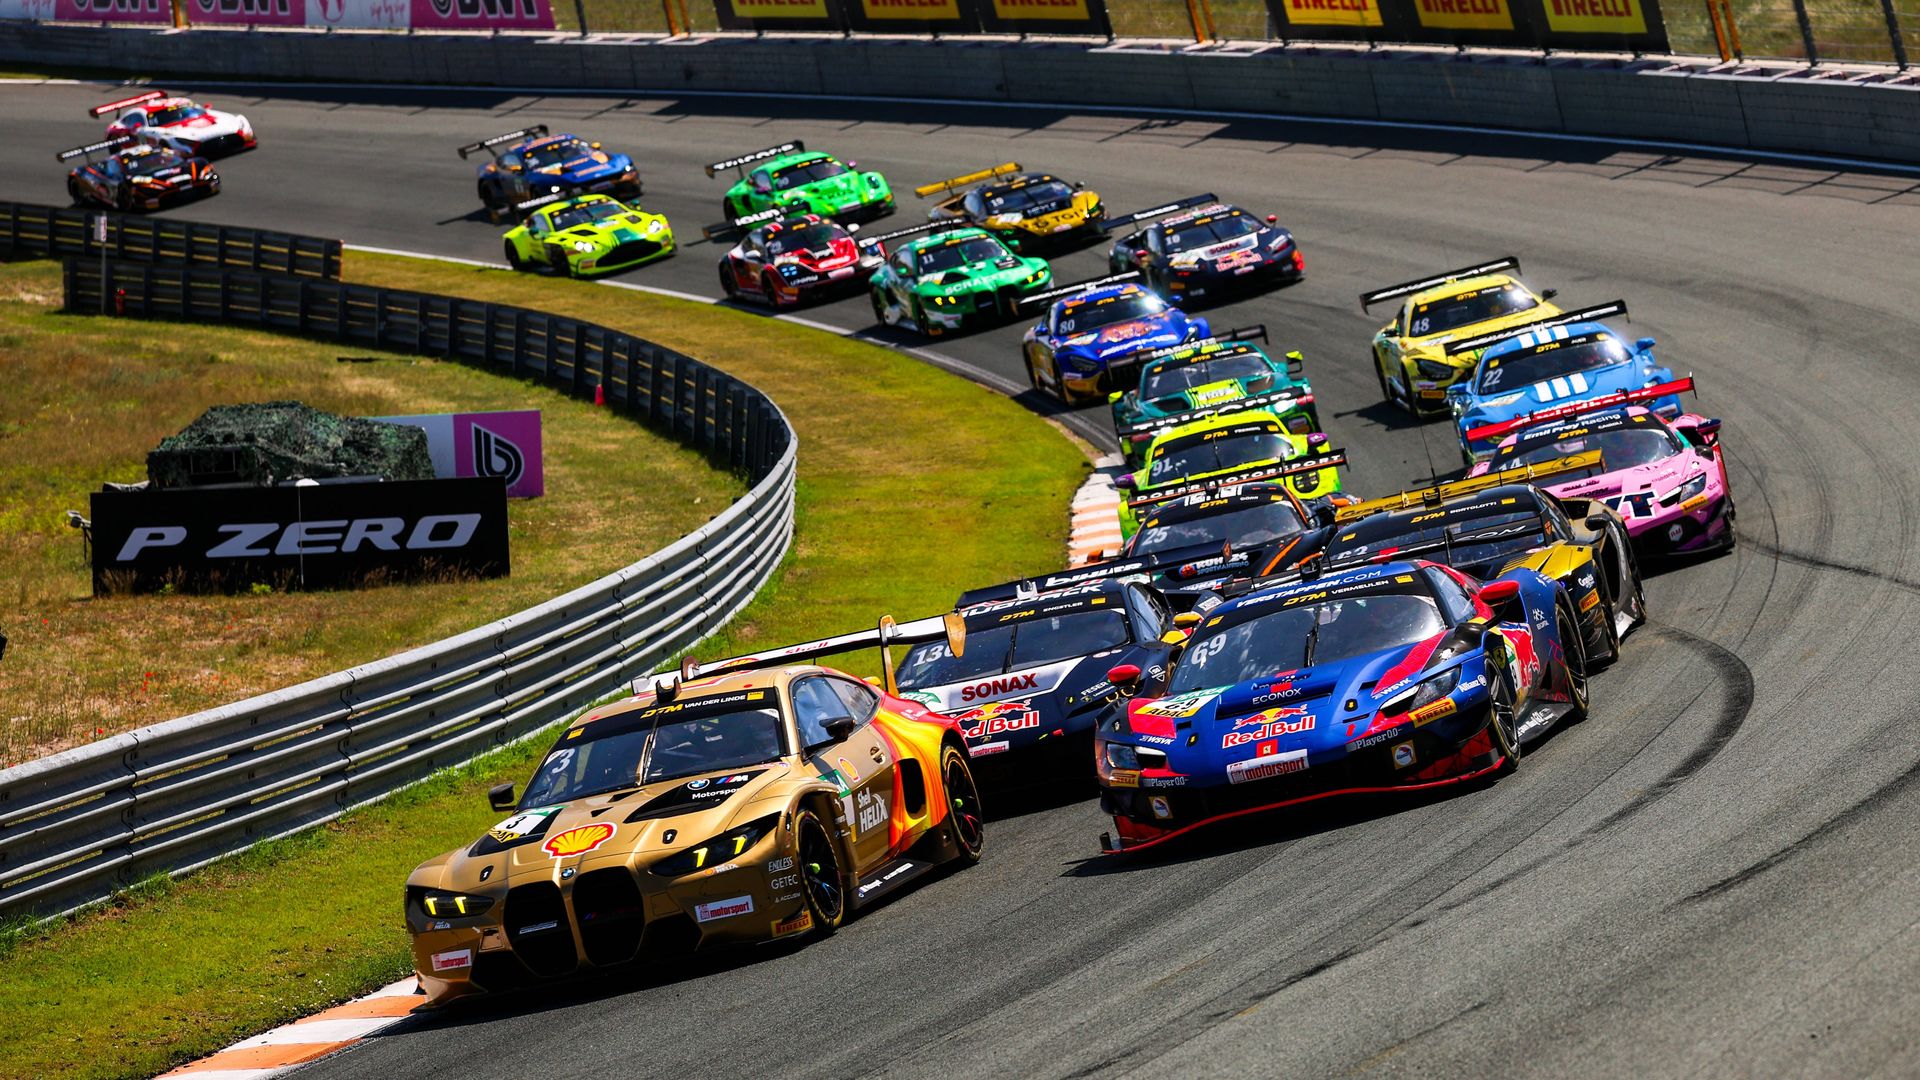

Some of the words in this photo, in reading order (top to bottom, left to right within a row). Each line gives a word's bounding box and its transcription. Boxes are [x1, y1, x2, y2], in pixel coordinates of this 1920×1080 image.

[1058, 319, 1075, 336] 80
[1412, 318, 1431, 334] 48
[1536, 343, 1560, 353] DTM
[1151, 376, 1161, 389] 7
[1483, 368, 1504, 388] 22
[1203, 430, 1229, 441] DTM
[1524, 428, 1551, 441] Emil
[1552, 422, 1580, 436] Frey
[1581, 413, 1622, 427] Racing
[1557, 428, 1589, 440] DTM
[1152, 457, 1174, 478] 91
[1199, 498, 1230, 510] DTM
[1410, 511, 1446, 524] DTM
[116, 526, 187, 561] P
[205, 513, 482, 558] ZERO
[1141, 526, 1171, 546] 25
[1236, 570, 1382, 608] VERSTAPPEN.COM
[1283, 592, 1328, 607] DTM
[1331, 579, 1390, 595] VERMEULEN
[999, 610, 1036, 622] DTM
[786, 641, 829, 655] Shell
[1191, 633, 1228, 667] 69
[962, 673, 1039, 701] SONAX
[1080, 681, 1107, 696] FESER
[1380, 677, 1413, 697] WSVK
[1458, 679, 1481, 693] Allianz
[640, 702, 684, 719] DTM
[685, 700, 703, 709] VAN
[703, 696, 720, 706] DER
[720, 693, 747, 705] LINDE
[1164, 697, 1200, 711] 69
[1252, 688, 1303, 706] ECONOX
[1146, 706, 1190, 718] ADAC
[1415, 701, 1454, 724] PIRELLI
[988, 710, 1040, 736] Bull
[1222, 724, 1268, 749] Red
[1269, 715, 1317, 738] Bull
[1147, 736, 1175, 746] WSVK
[552, 748, 576, 774] 3
[1245, 757, 1306, 781] motorsport
[857, 787, 872, 809] Shell
[507, 815, 527, 830] 3
[859, 794, 889, 834] HELIX
[768, 856, 794, 872] ENDLESS
[771, 875, 799, 890] GETEC
[709, 901, 751, 918] motorsport
[775, 913, 810, 934] PIRELLI
